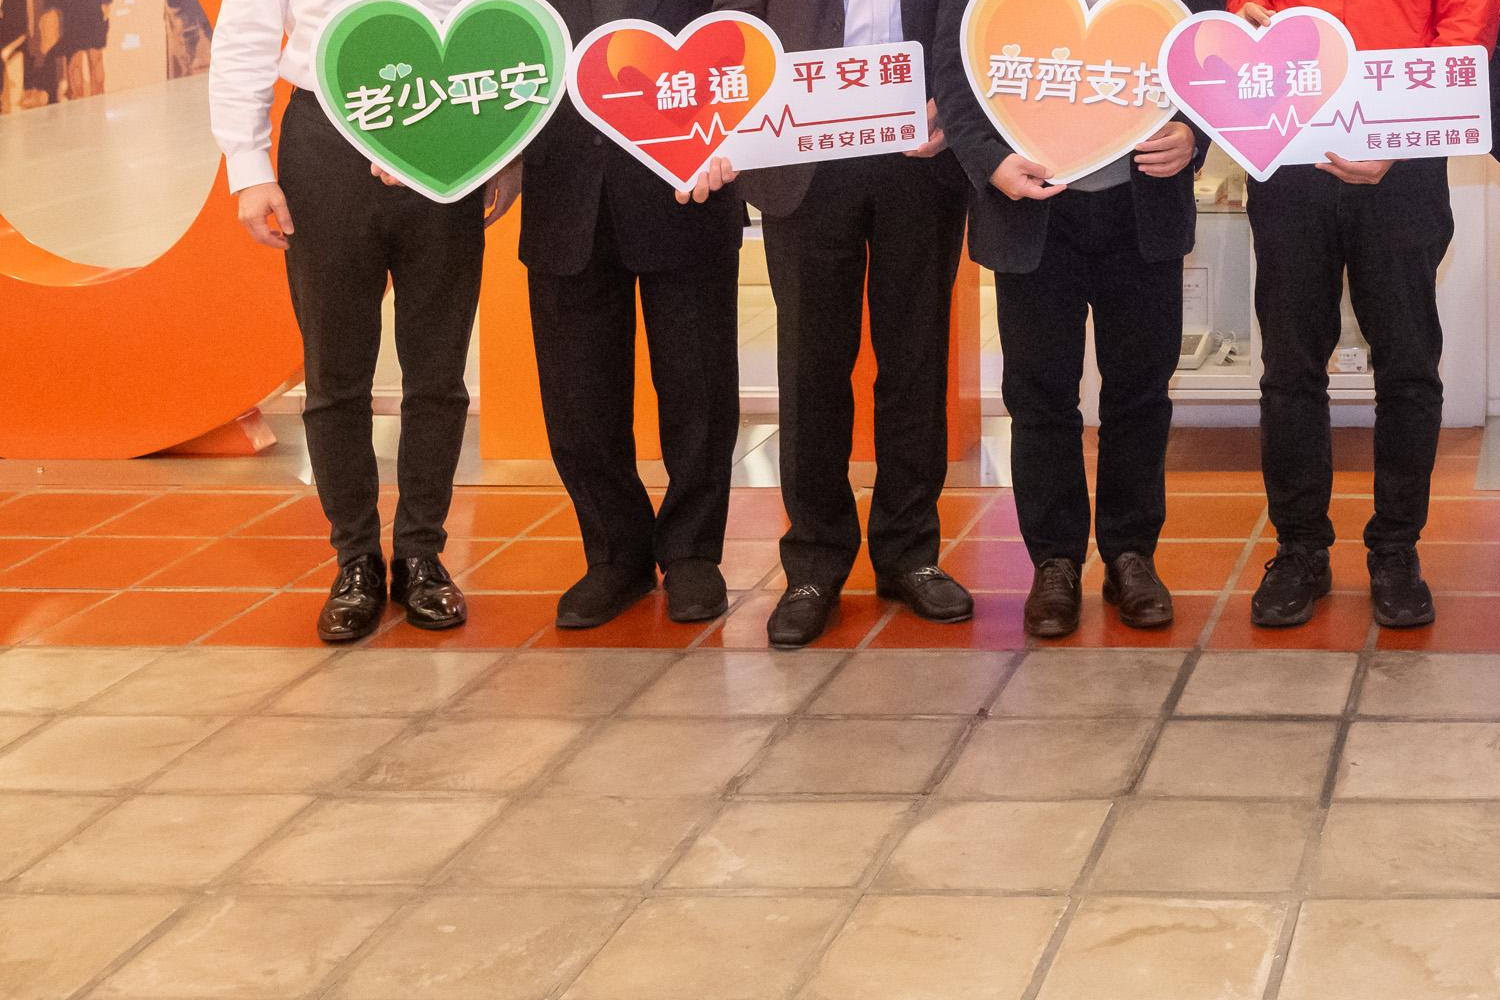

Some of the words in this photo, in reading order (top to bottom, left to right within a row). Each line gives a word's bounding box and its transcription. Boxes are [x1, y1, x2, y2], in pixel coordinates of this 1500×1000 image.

[345, 62, 551, 132] 老少平安
[602, 65, 750, 111] 一線通
[792, 53, 915, 94] 平安鐘
[986, 45, 1171, 108] 齊齊支持
[1189, 60, 1323, 99] 一線通
[1363, 56, 1478, 92] 平安鐘
[797, 123, 917, 153] 長者安居協會
[1366, 128, 1480, 149] 長者安居協會
